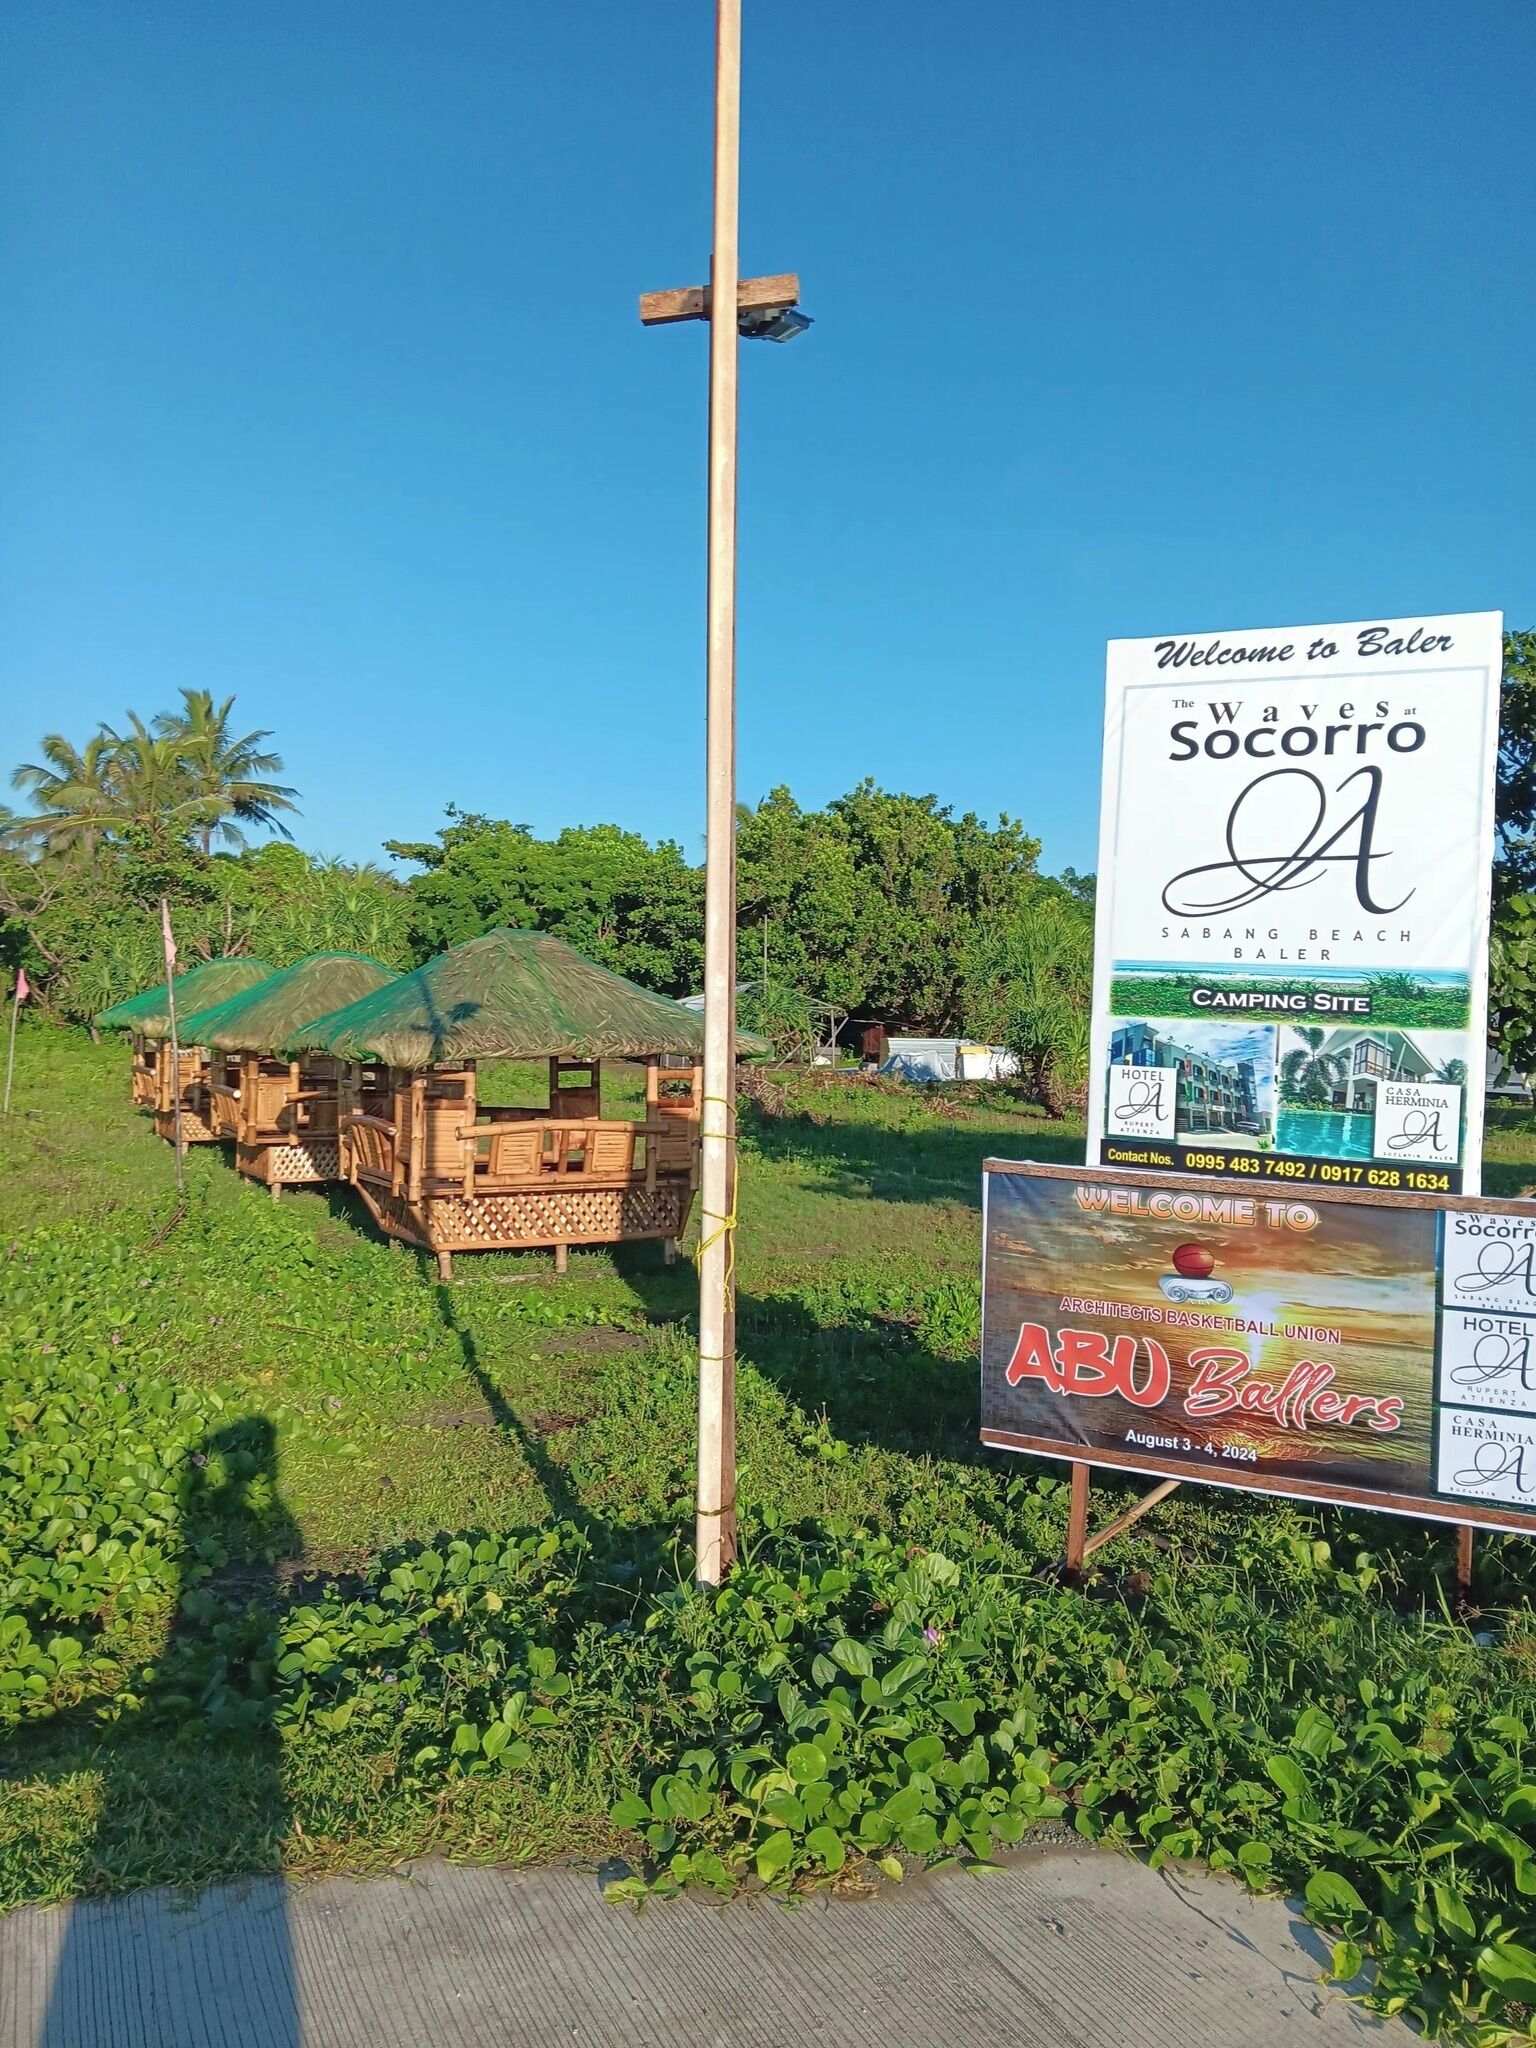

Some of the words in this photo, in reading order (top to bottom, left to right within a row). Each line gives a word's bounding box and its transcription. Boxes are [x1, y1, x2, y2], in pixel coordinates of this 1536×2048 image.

[1154, 639, 1295, 669] Welcome
[1307, 637, 1338, 660] to
[1357, 627, 1454, 658] Baler
[1172, 698, 1195, 709] The
[1208, 700, 1390, 725] Waves
[1404, 706, 1417, 716] at
[1168, 720, 1426, 761] Socorro
[1162, 927, 1279, 940] SABANG
[1309, 929, 1412, 942] BEACH
[1234, 947, 1331, 961] BALER
[1121, 1069, 1165, 1082] HOTEL
[1386, 1087, 1421, 1097] CASA
[1385, 1095, 1449, 1108] HERMINIA
[1120, 1127, 1160, 1135] ATIENZA
[1107, 1148, 1149, 1163] Contact
[1150, 1152, 1175, 1165] Nos.
[1186, 1153, 1226, 1170] 0995
[1229, 1156, 1260, 1173] 483
[1264, 1160, 1306, 1178] 7492
[1309, 1163, 1317, 1179] /
[1320, 1165, 1363, 1183] 0917
[1367, 1169, 1401, 1187] 628
[1406, 1172, 1450, 1191] 1634
[1075, 1186, 1256, 1225] WELCOME
[1265, 1200, 1318, 1231] TO
[1455, 1219, 1536, 1239] Socorr
[1469, 1214, 1536, 1227] Waves
[1508, 1299, 1536, 1307] BEAC
[1059, 1296, 1162, 1322] ARCHITECTS
[1166, 1310, 1280, 1337] BASKETBALL
[1284, 1324, 1341, 1344] UNION
[1463, 1316, 1534, 1337] HOTEL
[1006, 1322, 1171, 1408] ABU
[1184, 1347, 1404, 1431] Ballers
[1467, 1385, 1516, 1397] RUPERT
[1461, 1394, 1527, 1407] ATIENZA
[1453, 1415, 1497, 1429] CASA
[1452, 1425, 1534, 1445] HERMINIA
[1125, 1429, 1179, 1449] August
[1182, 1437, 1191, 1451] 3
[1203, 1442, 1217, 1457] 4,
[1221, 1444, 1258, 1462] 2024
